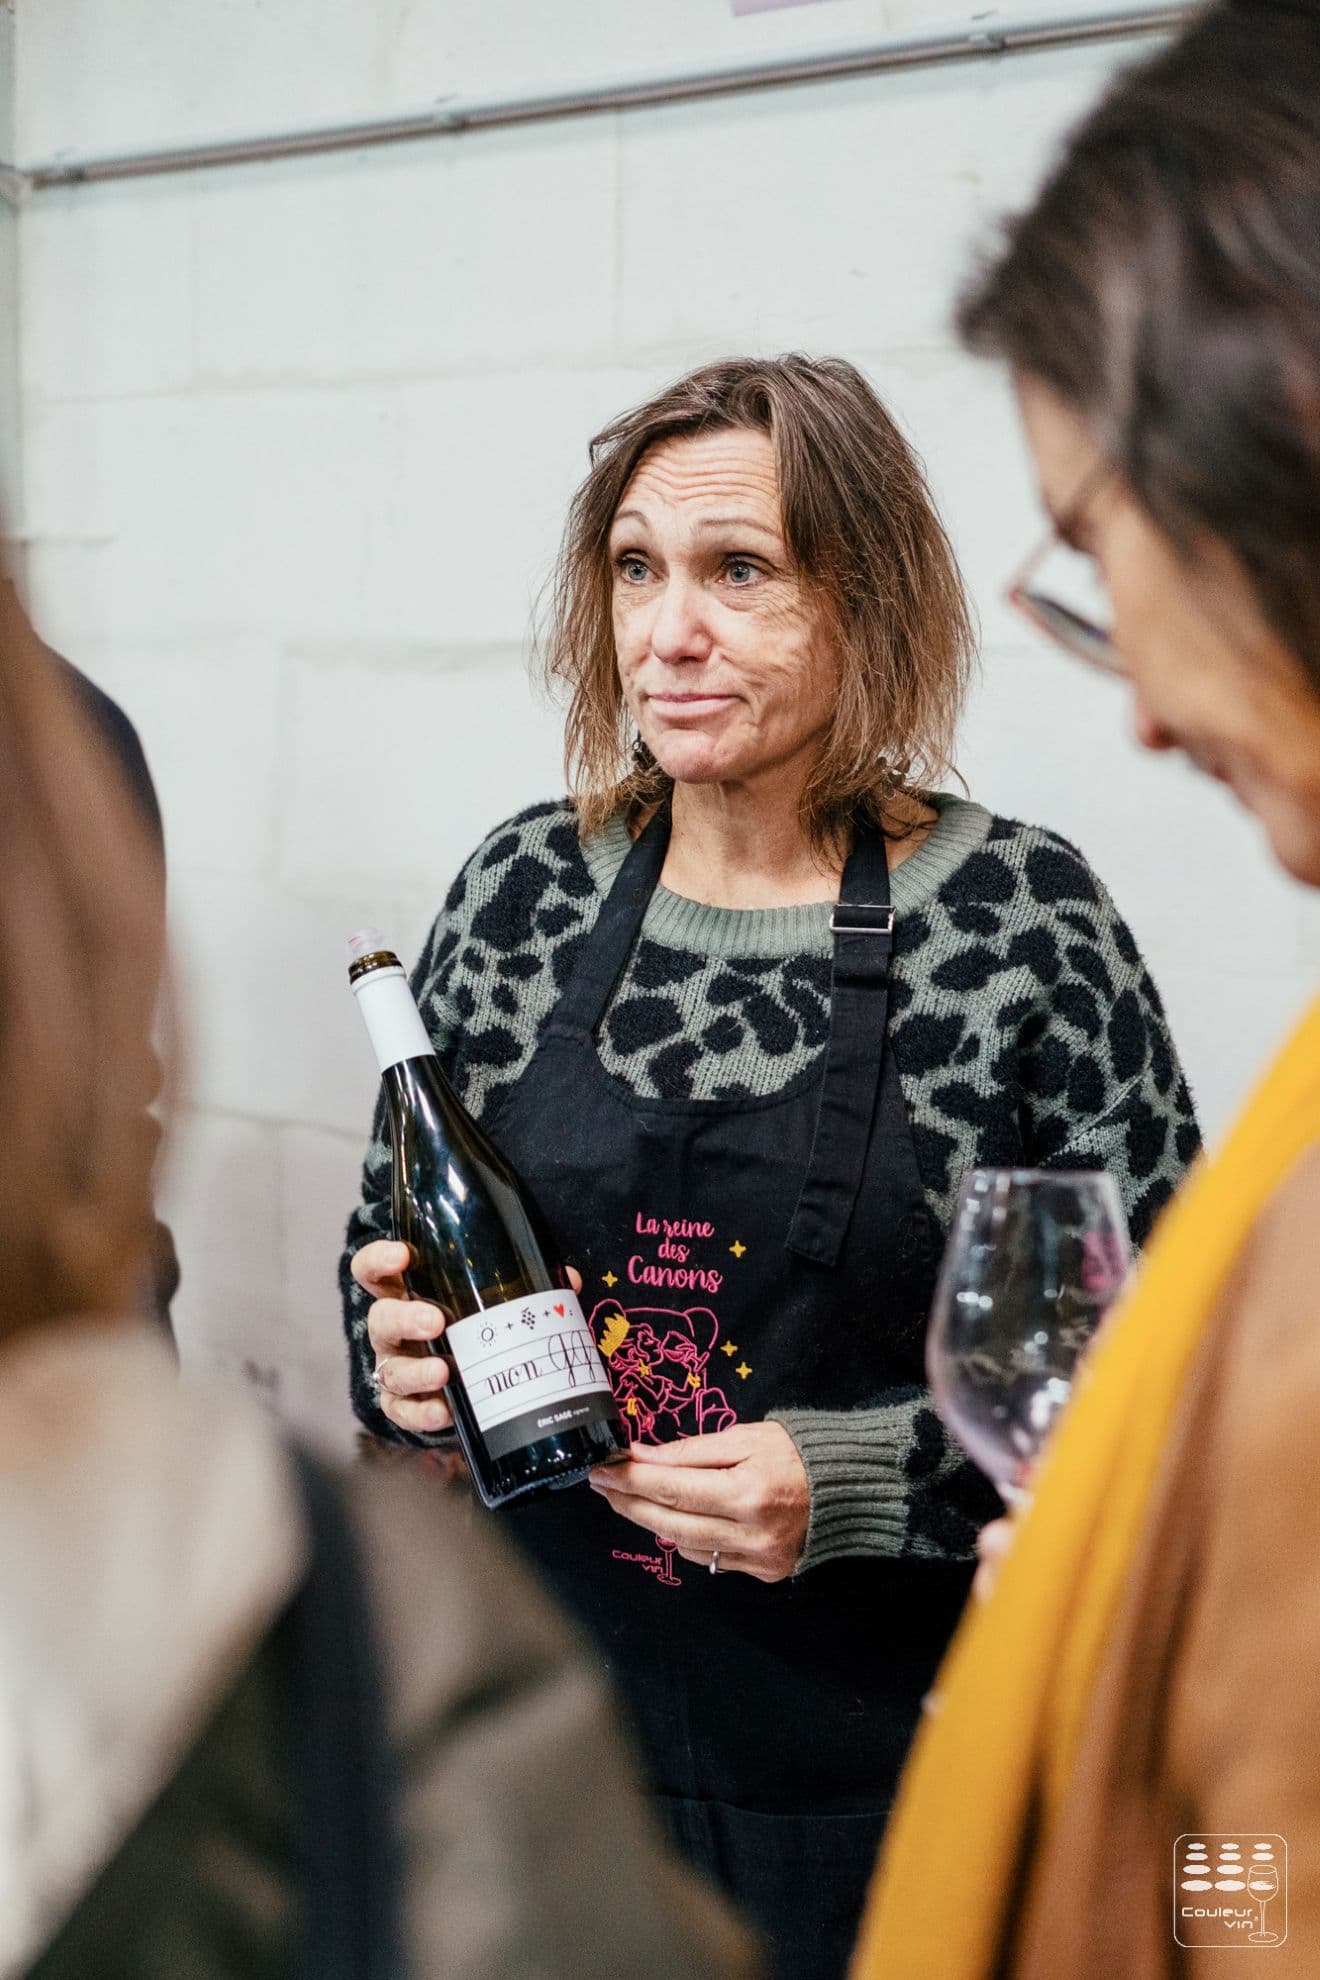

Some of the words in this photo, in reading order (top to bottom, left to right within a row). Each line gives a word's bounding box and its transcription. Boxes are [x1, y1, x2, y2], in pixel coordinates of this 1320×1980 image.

[635, 1211, 660, 1235] La
[662, 1218, 715, 1238] reine
[657, 1237, 690, 1263] des
[627, 1255, 723, 1294] Canons
[487, 1360, 543, 1395] mon
[612, 1549, 663, 1565] Couleur
